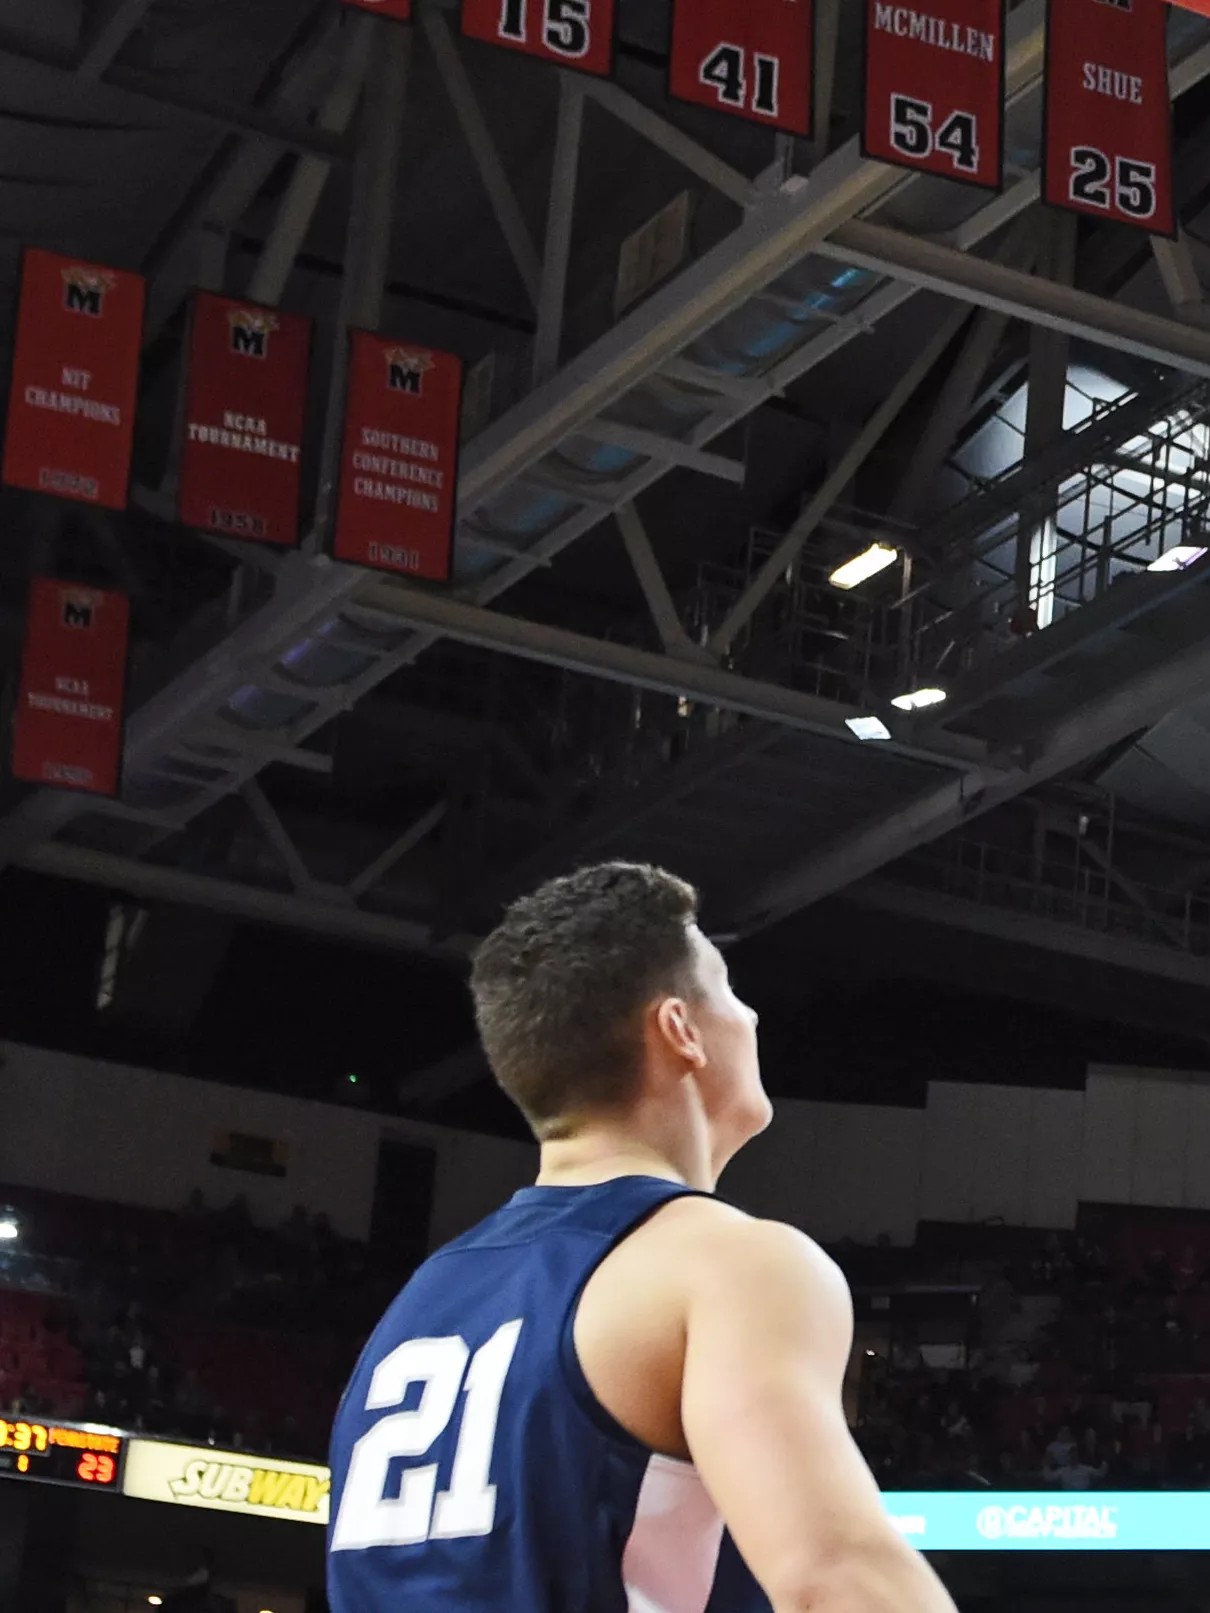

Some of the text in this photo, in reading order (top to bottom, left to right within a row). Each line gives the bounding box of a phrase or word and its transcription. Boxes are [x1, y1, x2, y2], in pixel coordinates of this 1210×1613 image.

[498, 0, 591, 58] 15
[873, 2, 995, 63] MCMILLEN
[699, 41, 778, 117] 41
[1082, 62, 1143, 104] SHUE
[890, 93, 979, 173] 54
[1069, 145, 1156, 219] 25
[25, 385, 120, 426] CHAMPIONS
[224, 410, 267, 436] NCAA
[188, 423, 300, 462] TOURNAMENT
[362, 427, 439, 461] SOUTHERN
[353, 451, 444, 489] CONFERENCE
[354, 476, 439, 513] CHAMPIONS
[330, 1318, 523, 1552] 21
[77, 1452, 115, 1483] 23
[168, 1459, 330, 1512] SUBWAY
